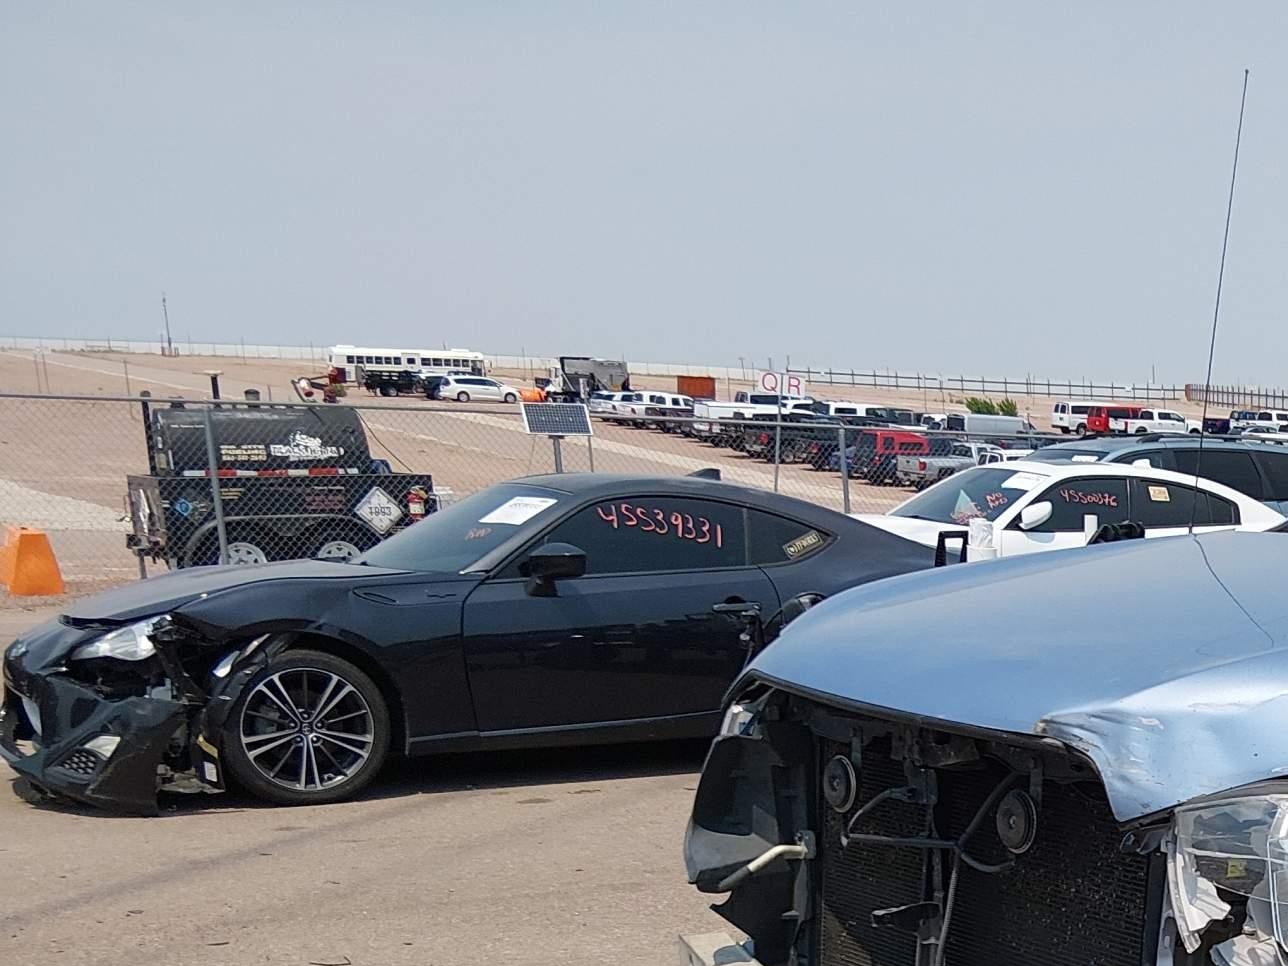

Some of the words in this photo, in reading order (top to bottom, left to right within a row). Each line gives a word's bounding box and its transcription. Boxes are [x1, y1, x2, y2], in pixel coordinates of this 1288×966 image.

[762, 372, 777, 392] Q
[787, 375, 801, 395] R
[597, 503, 722, 548] 45539331
